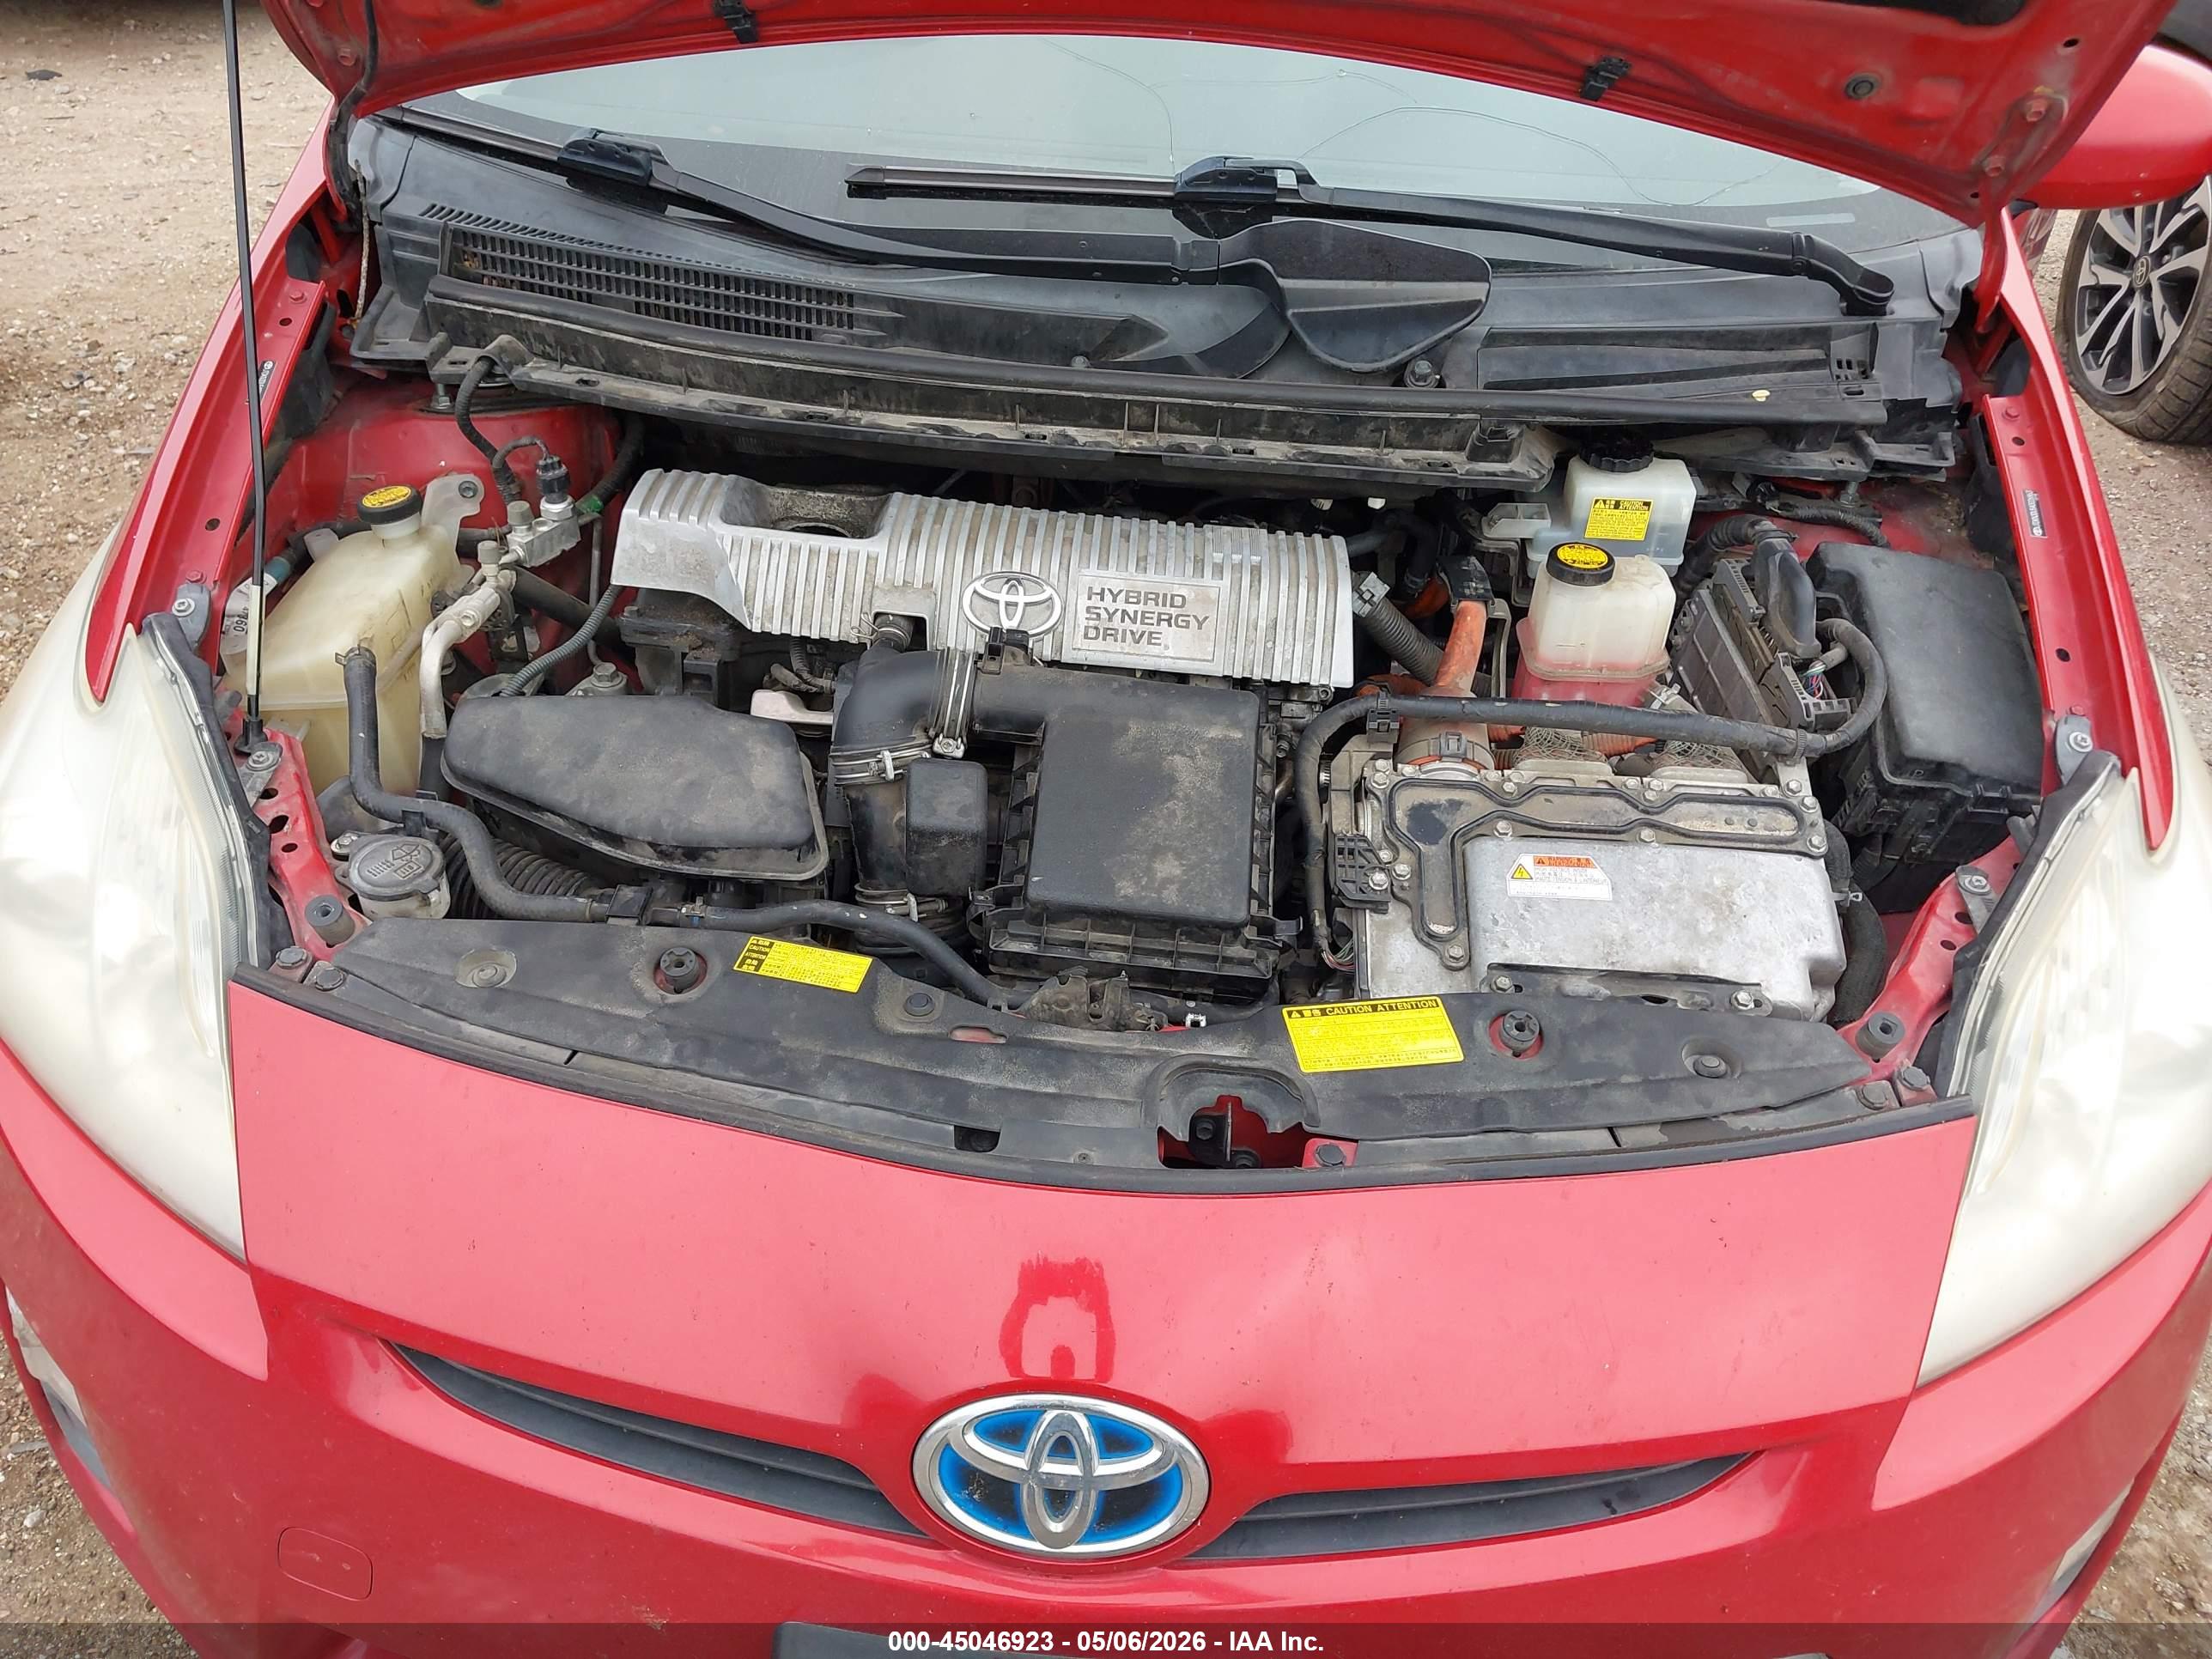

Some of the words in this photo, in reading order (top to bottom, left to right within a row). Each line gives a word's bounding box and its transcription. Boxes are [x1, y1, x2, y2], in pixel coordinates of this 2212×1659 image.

[1086, 586, 1187, 609] HYBRID
[1085, 605, 1210, 630] SYNERGY
[1083, 625, 1164, 646] DRIVE
[1326, 1005, 1373, 1016] CAUTION
[1377, 1000, 1437, 1012] ATTENTION
